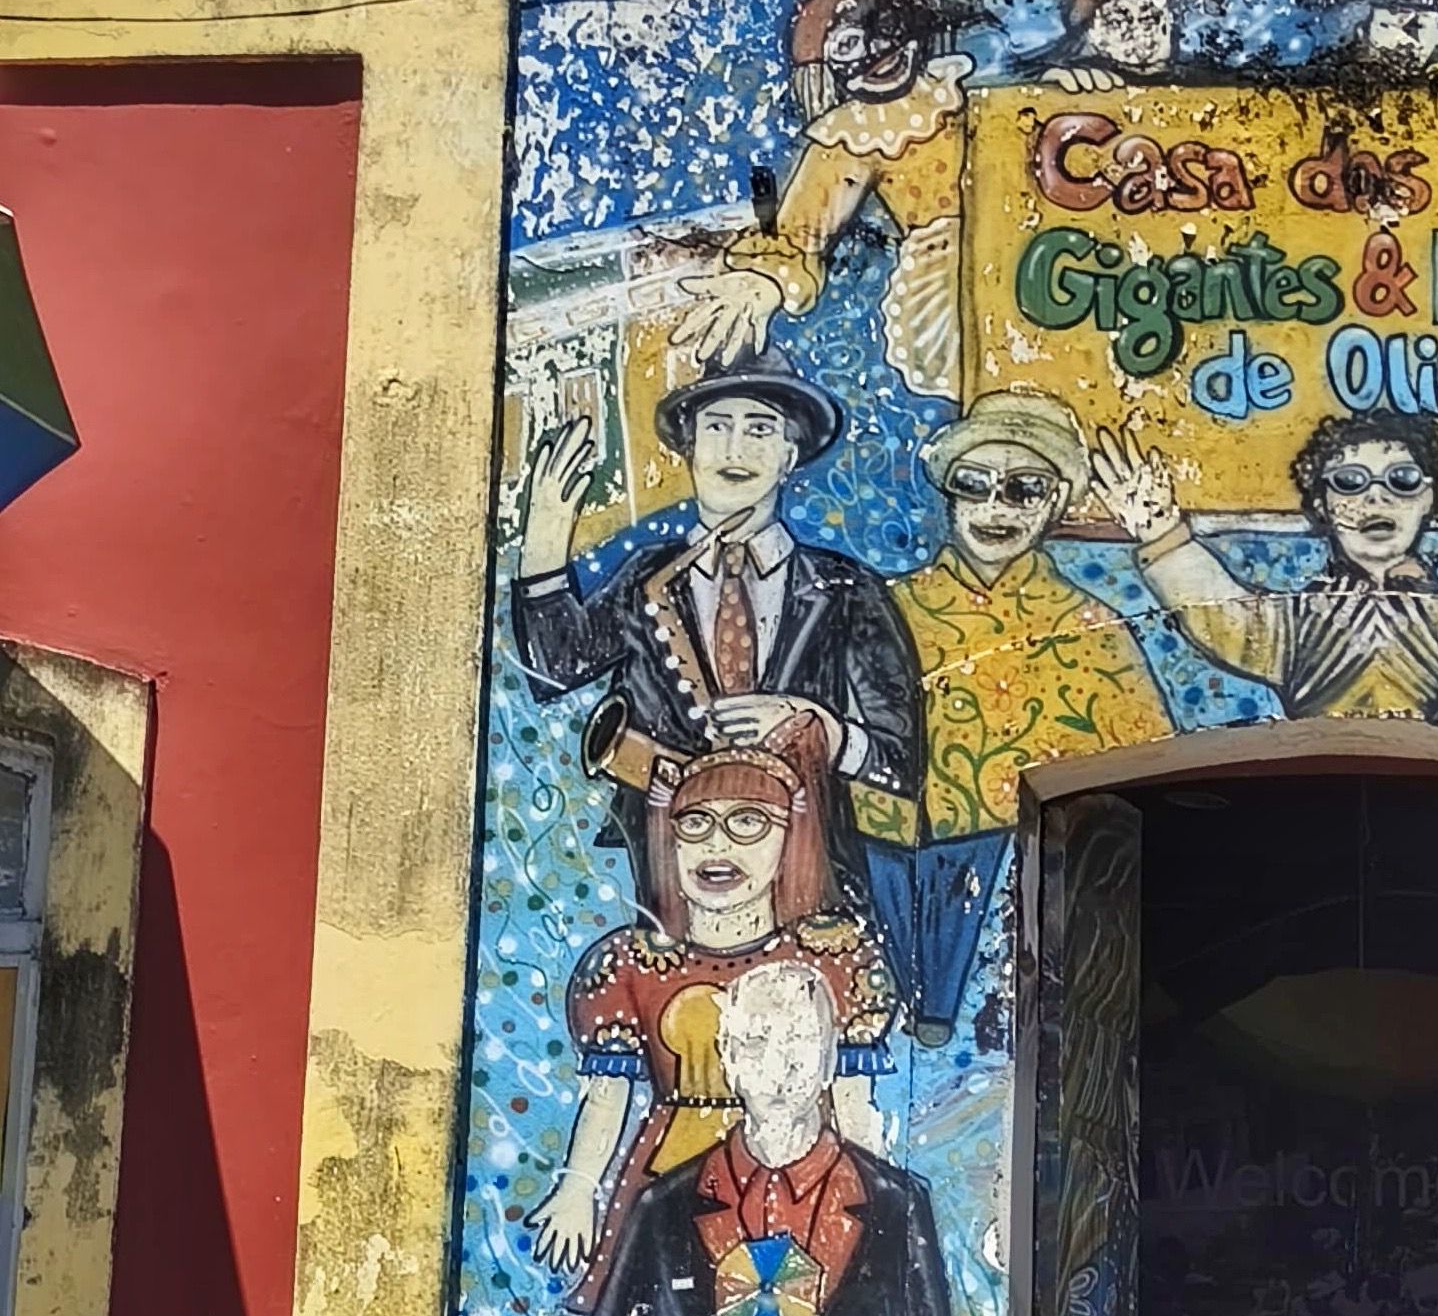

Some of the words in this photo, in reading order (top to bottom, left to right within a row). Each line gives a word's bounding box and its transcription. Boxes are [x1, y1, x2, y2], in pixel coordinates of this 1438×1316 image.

[1035, 111, 1256, 215] Casa
[1287, 127, 1431, 216] dos
[1016, 226, 1346, 377] Gigantes
[1353, 230, 1418, 318] &
[1190, 329, 1294, 420] de
